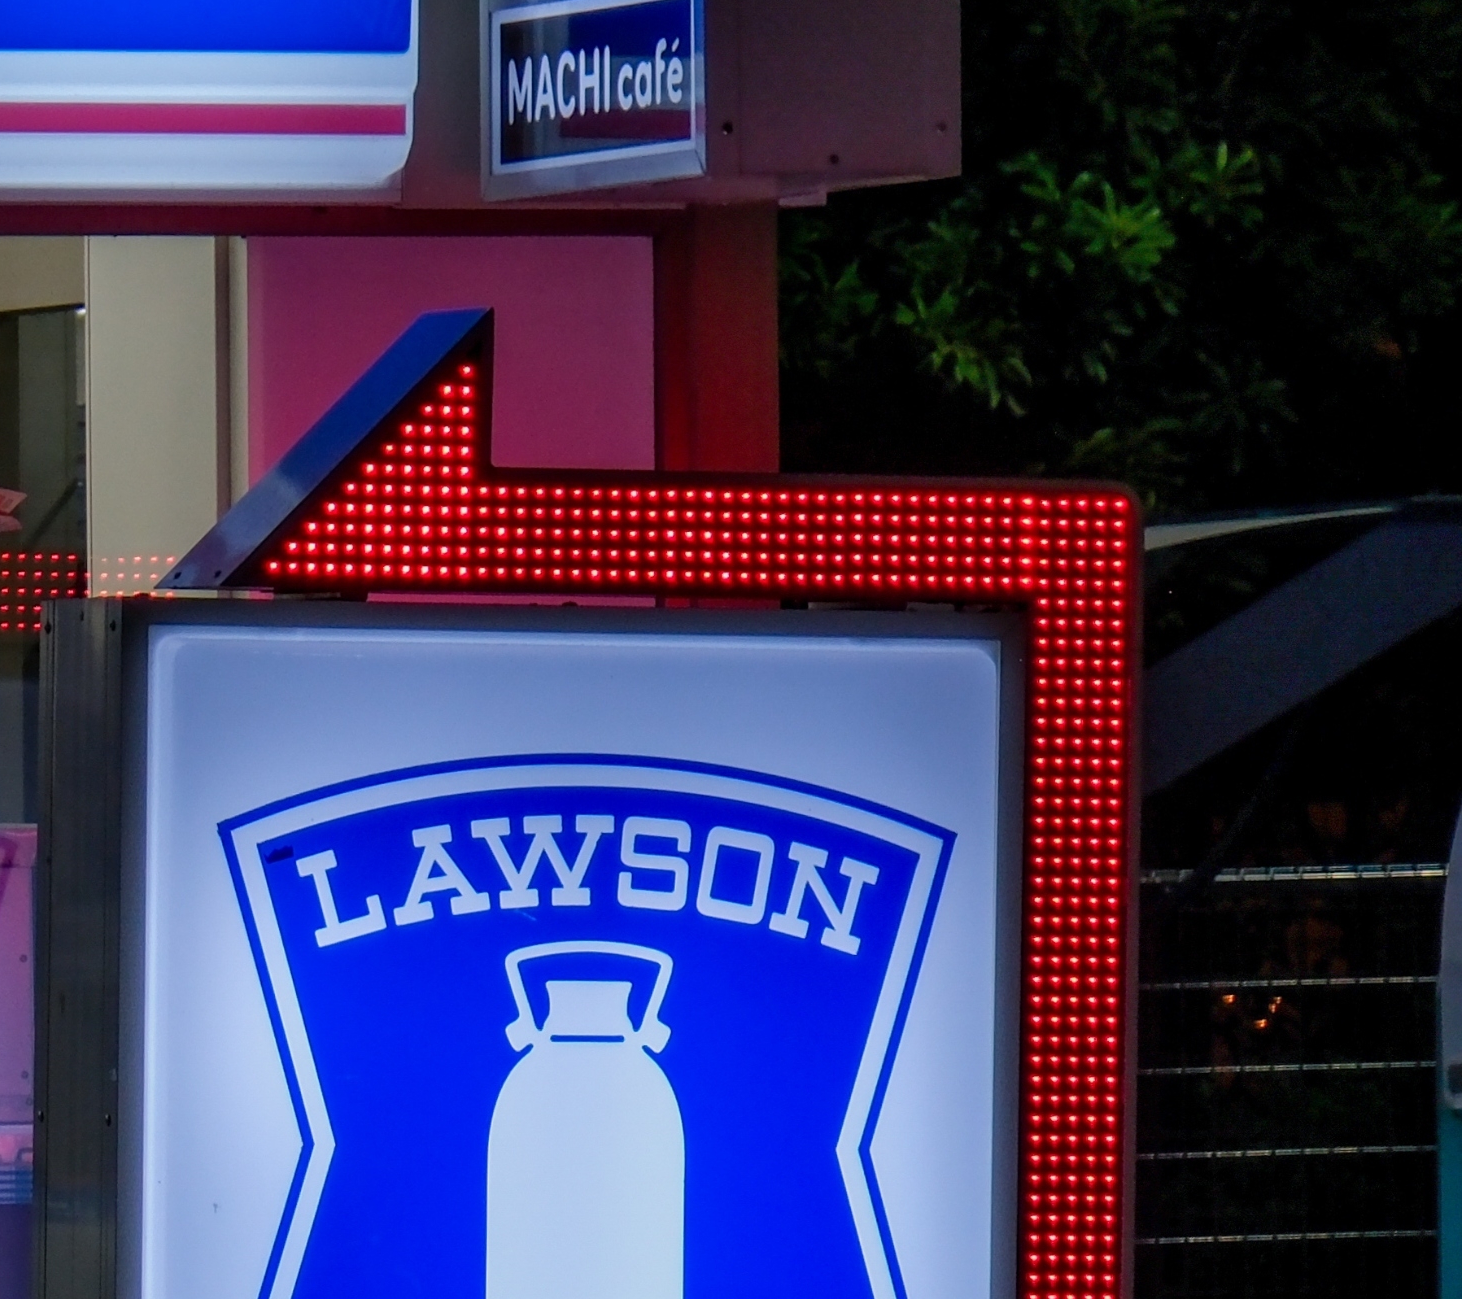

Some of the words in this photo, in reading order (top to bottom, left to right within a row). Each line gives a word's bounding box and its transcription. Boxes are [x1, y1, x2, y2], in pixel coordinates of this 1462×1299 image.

[507, 43, 612, 124] MACHI
[618, 36, 684, 109] café
[296, 814, 880, 955] LAWSON
